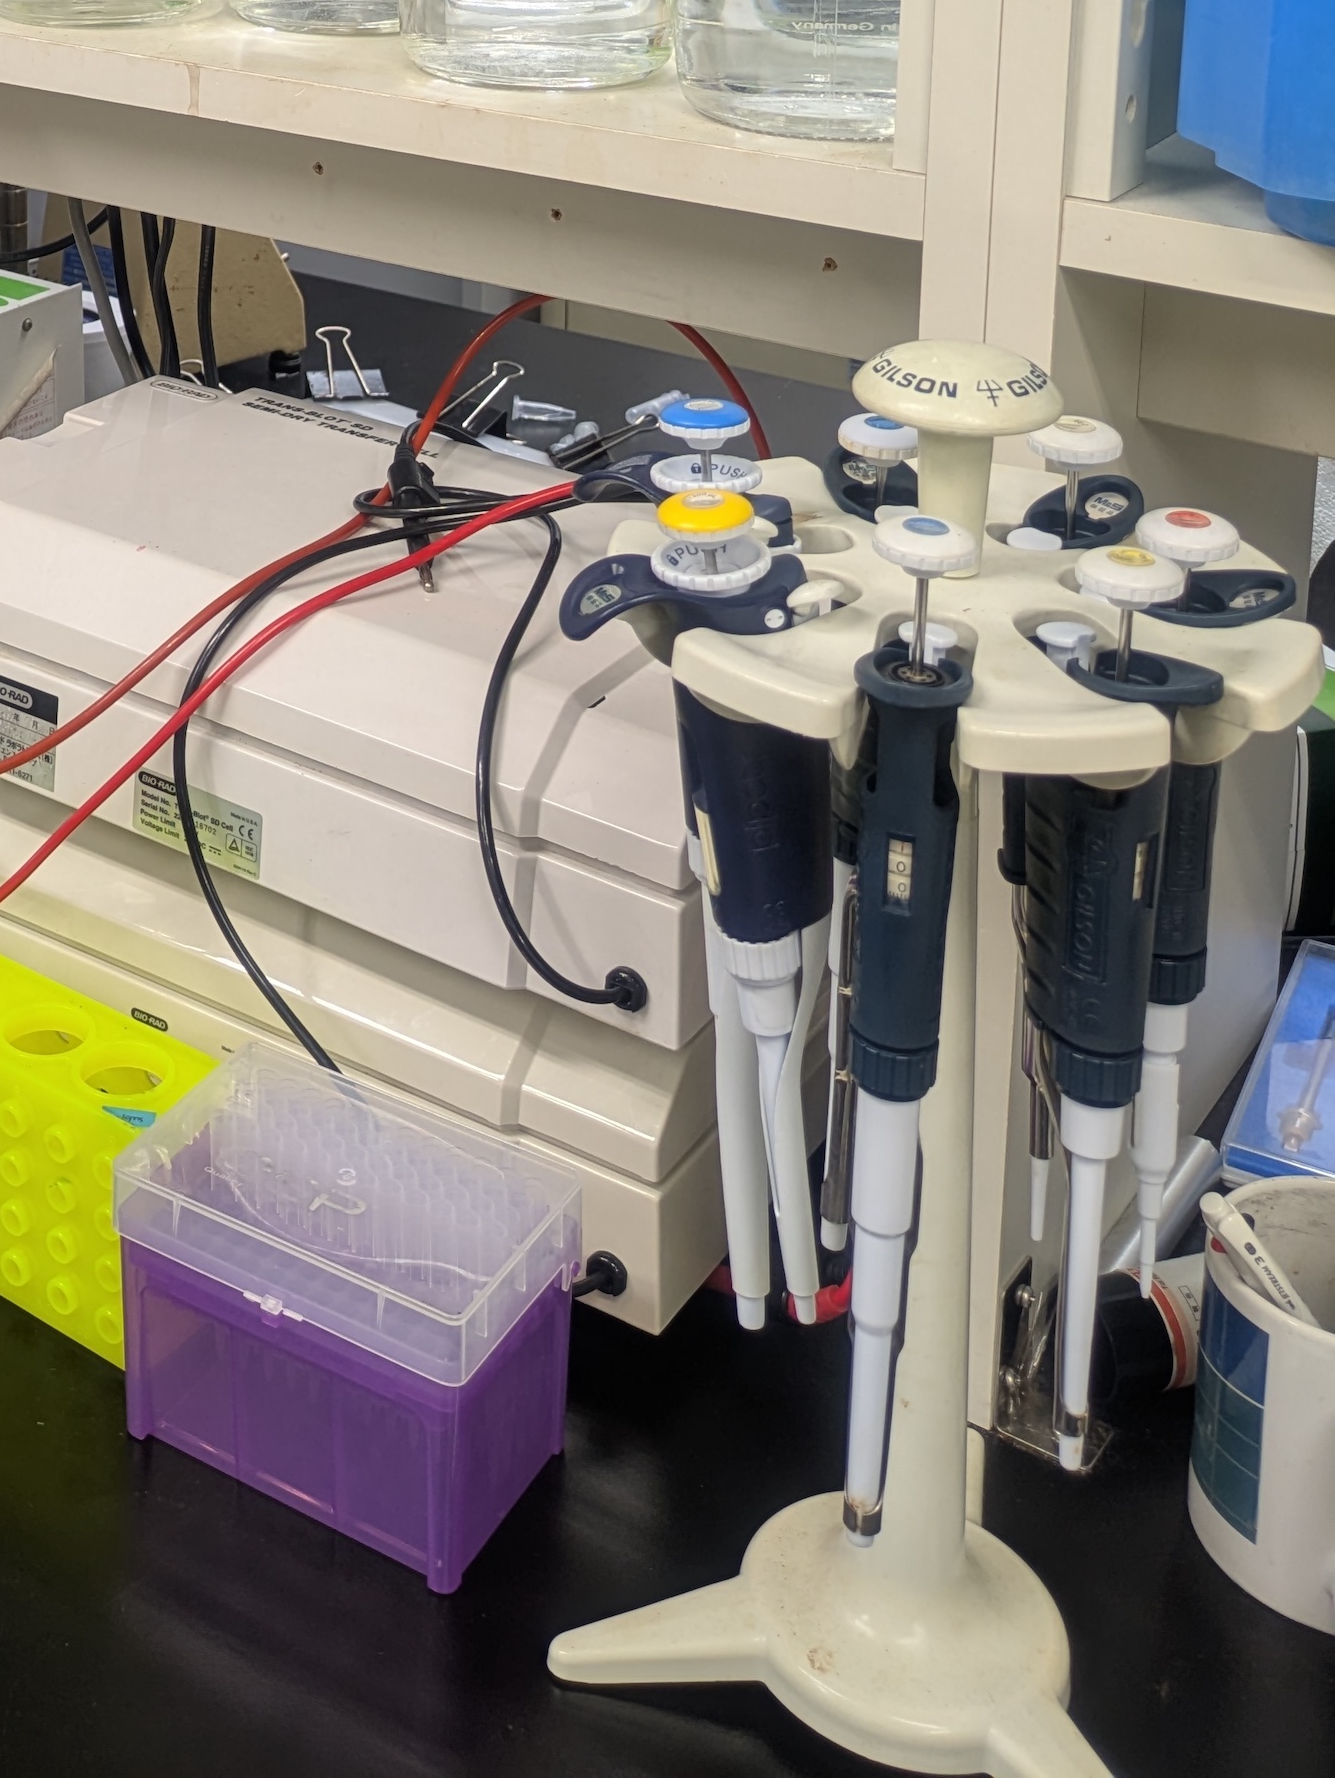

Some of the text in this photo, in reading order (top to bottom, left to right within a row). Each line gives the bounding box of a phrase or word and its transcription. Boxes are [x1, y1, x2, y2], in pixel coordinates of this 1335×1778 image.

[872, 358, 958, 398] GILSON
[140, 808, 176, 828] Power Limit
[141, 799, 170, 816] Serial No.
[141, 789, 234, 832] Model No. SD Cell
[140, 818, 180, 839] Voltage Limit
